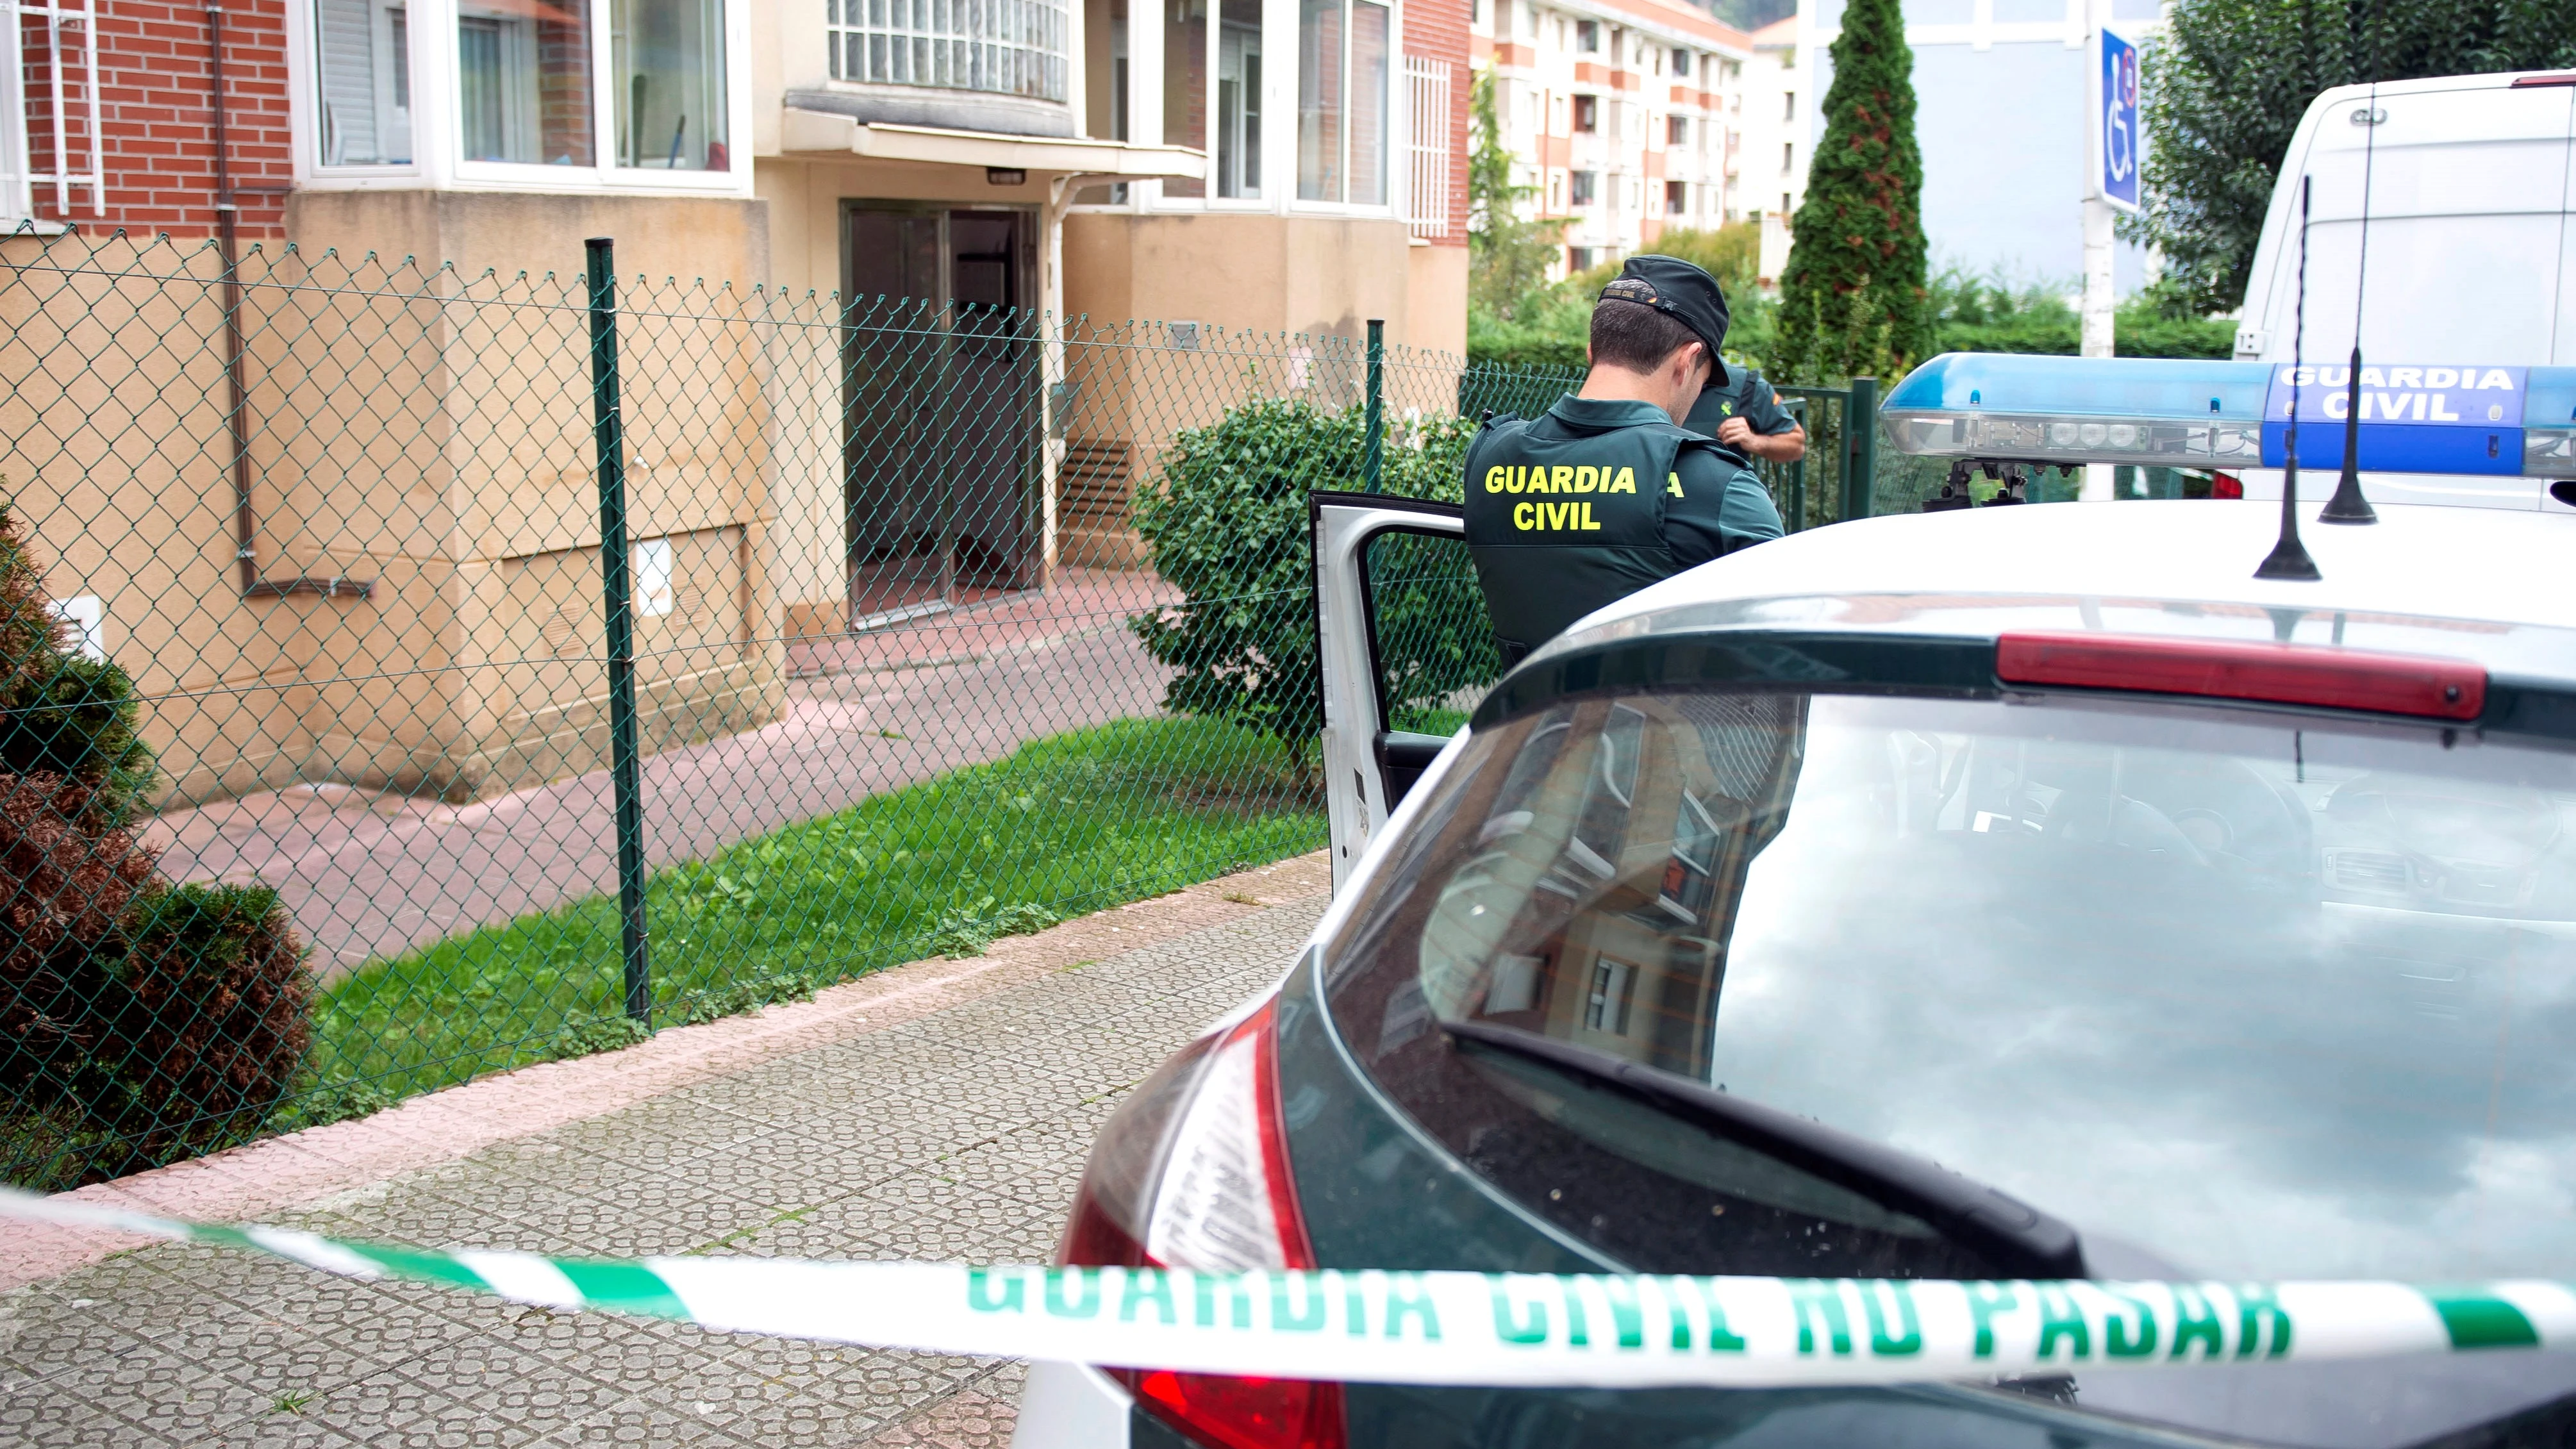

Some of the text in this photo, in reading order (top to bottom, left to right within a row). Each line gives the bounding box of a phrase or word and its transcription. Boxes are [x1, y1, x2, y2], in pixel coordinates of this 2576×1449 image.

[2281, 366, 2514, 390] GUARDIA
[2322, 392, 2459, 422] CIVIL
[1485, 465, 1636, 493] GUARDIA
[1513, 502, 1601, 531] CIVIL
